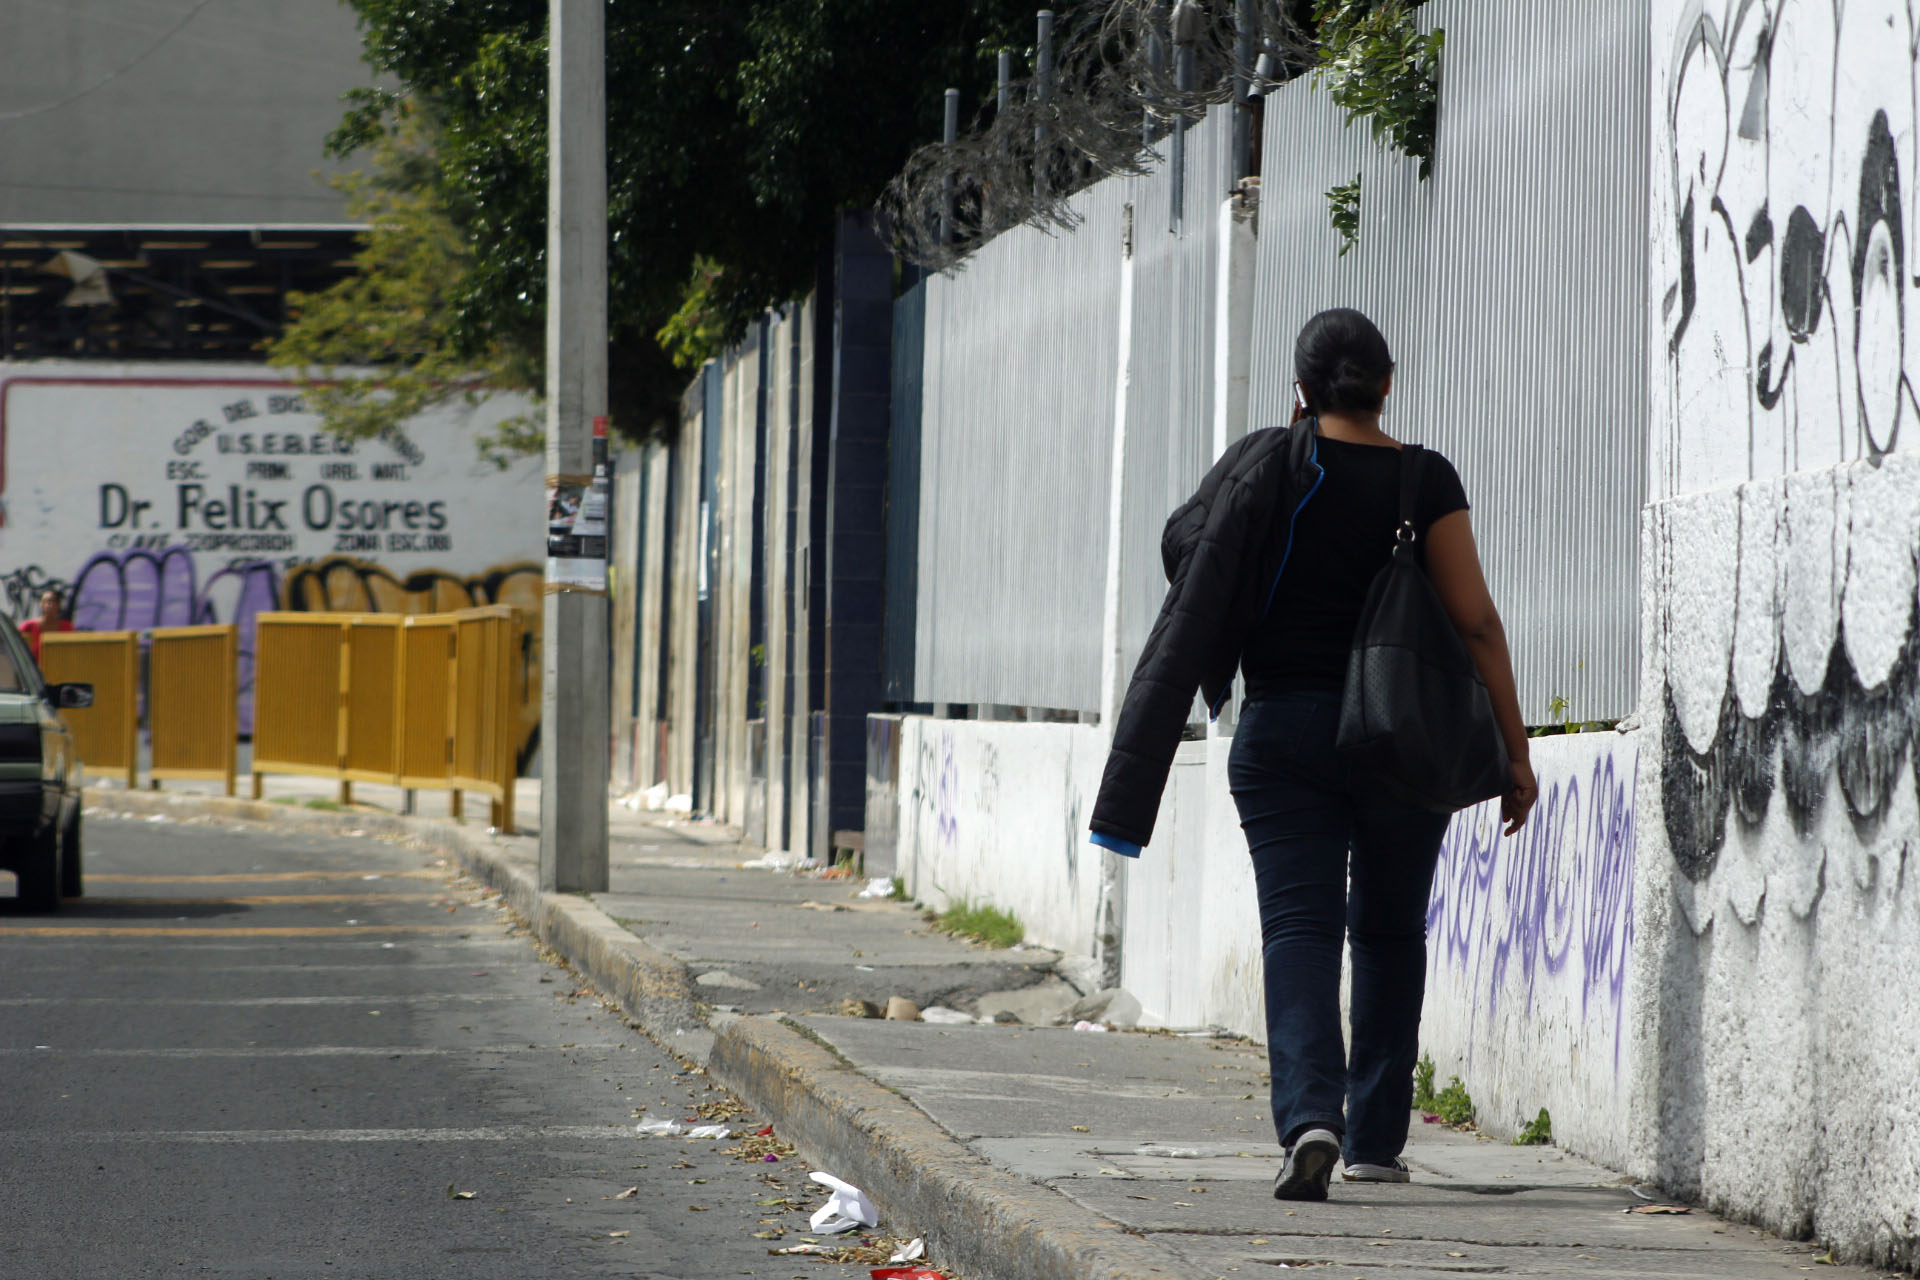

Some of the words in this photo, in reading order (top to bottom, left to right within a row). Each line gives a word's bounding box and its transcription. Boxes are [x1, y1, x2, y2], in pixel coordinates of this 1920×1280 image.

[166, 461, 209, 480] ESC.
[99, 482, 160, 530] Dr.
[175, 484, 288, 530] Felix
[302, 483, 448, 532] Osores
